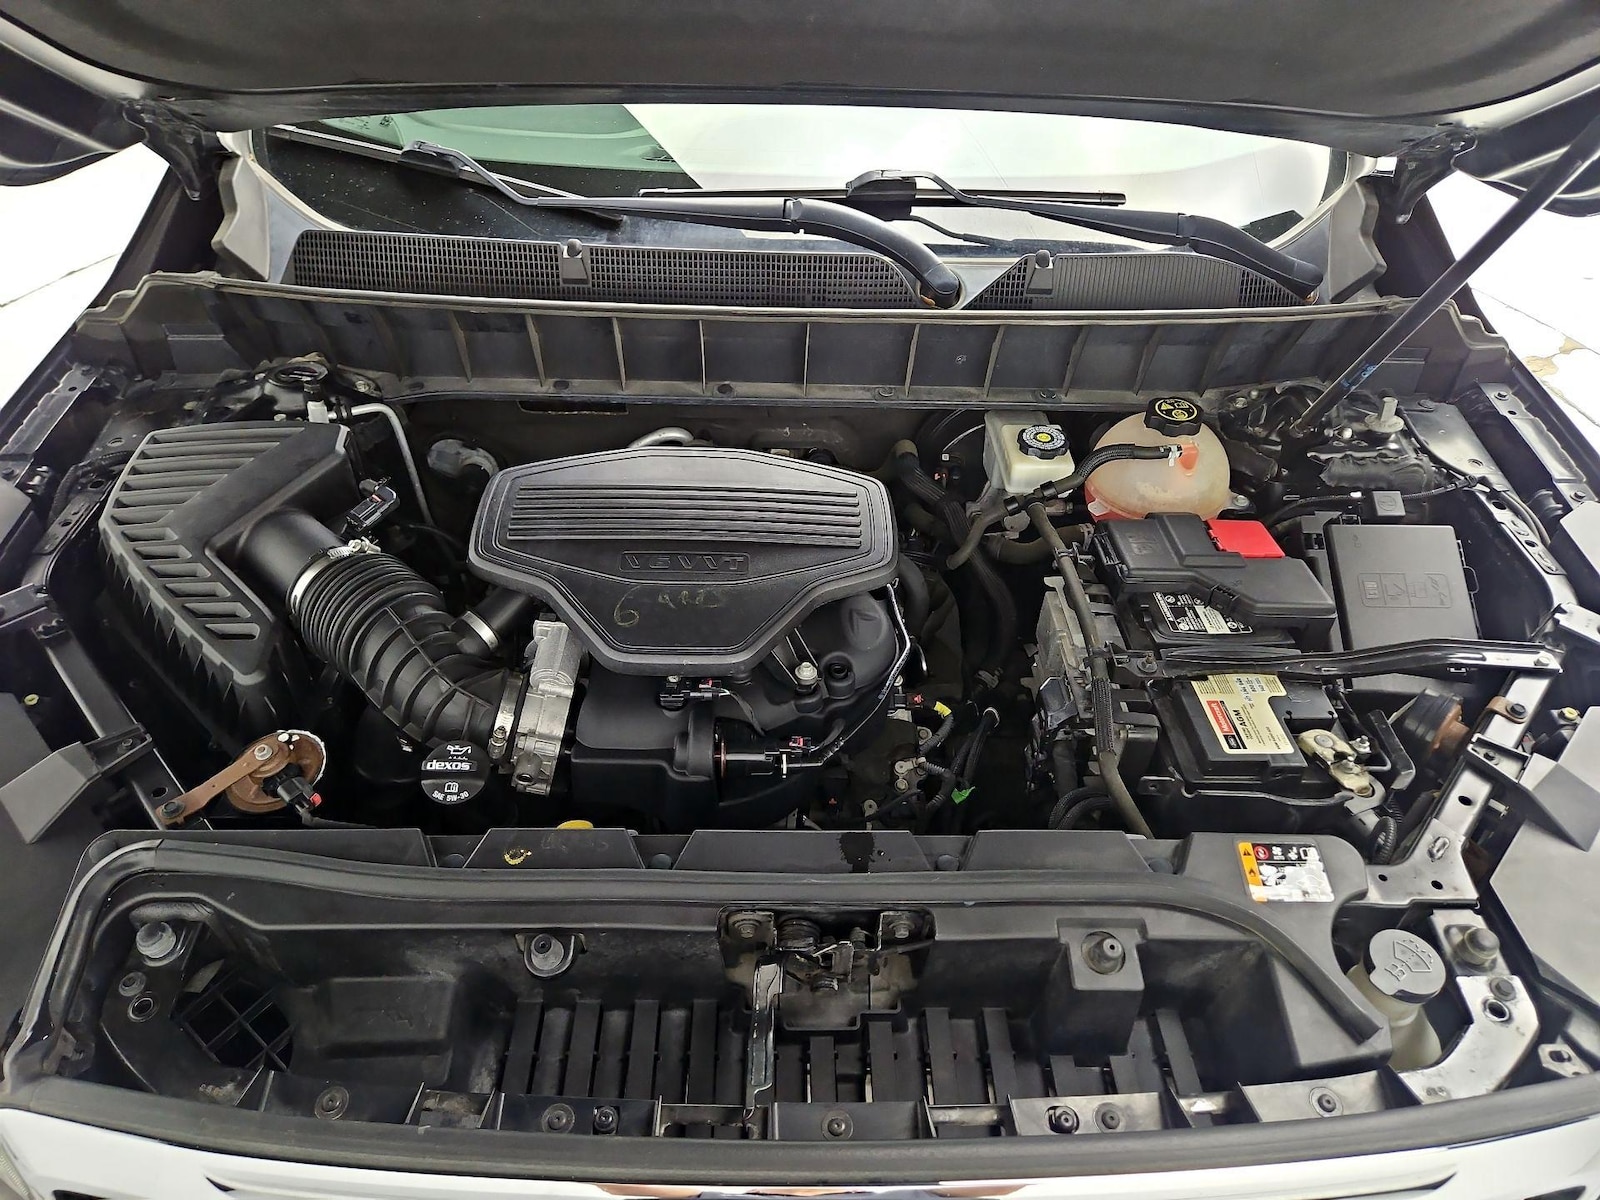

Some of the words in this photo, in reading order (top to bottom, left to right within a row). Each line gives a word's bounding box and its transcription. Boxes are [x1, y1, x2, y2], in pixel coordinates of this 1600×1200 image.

[1232, 709, 1248, 727] AGM
[426, 760, 472, 770] dexos
[432, 790, 445, 800] SAE
[446, 791, 469, 801] 5W-30
